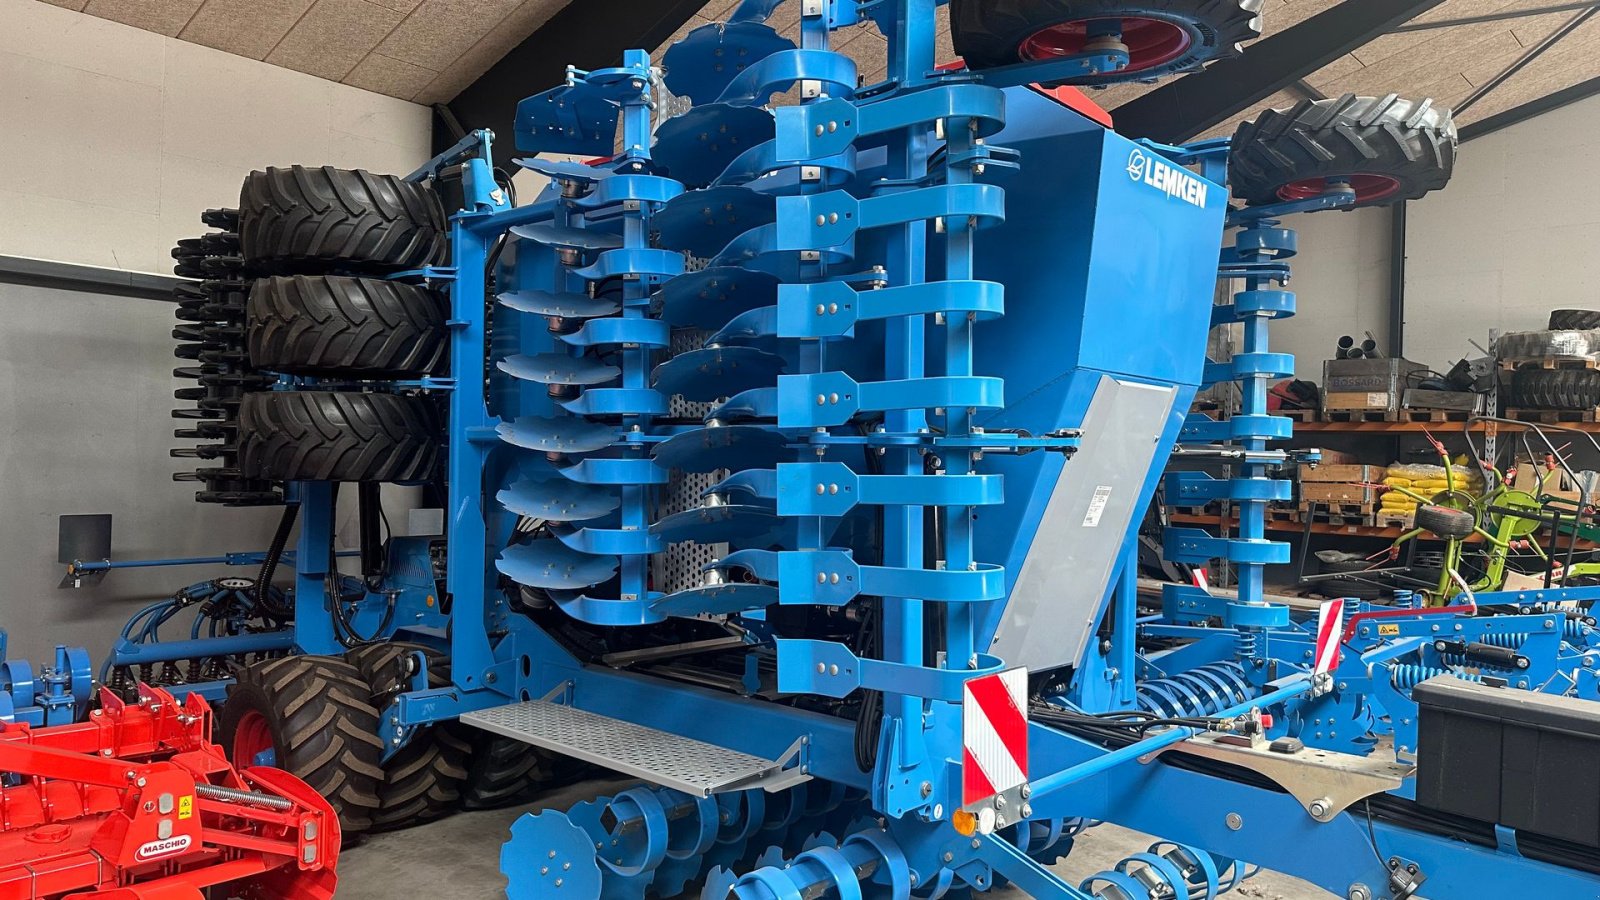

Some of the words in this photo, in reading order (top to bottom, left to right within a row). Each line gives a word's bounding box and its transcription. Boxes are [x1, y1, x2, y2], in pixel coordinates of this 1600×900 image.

[1144, 157, 1207, 209] LEMKEN
[1333, 378, 1381, 387] BOSSARD
[143, 839, 187, 854] MASCHIO
